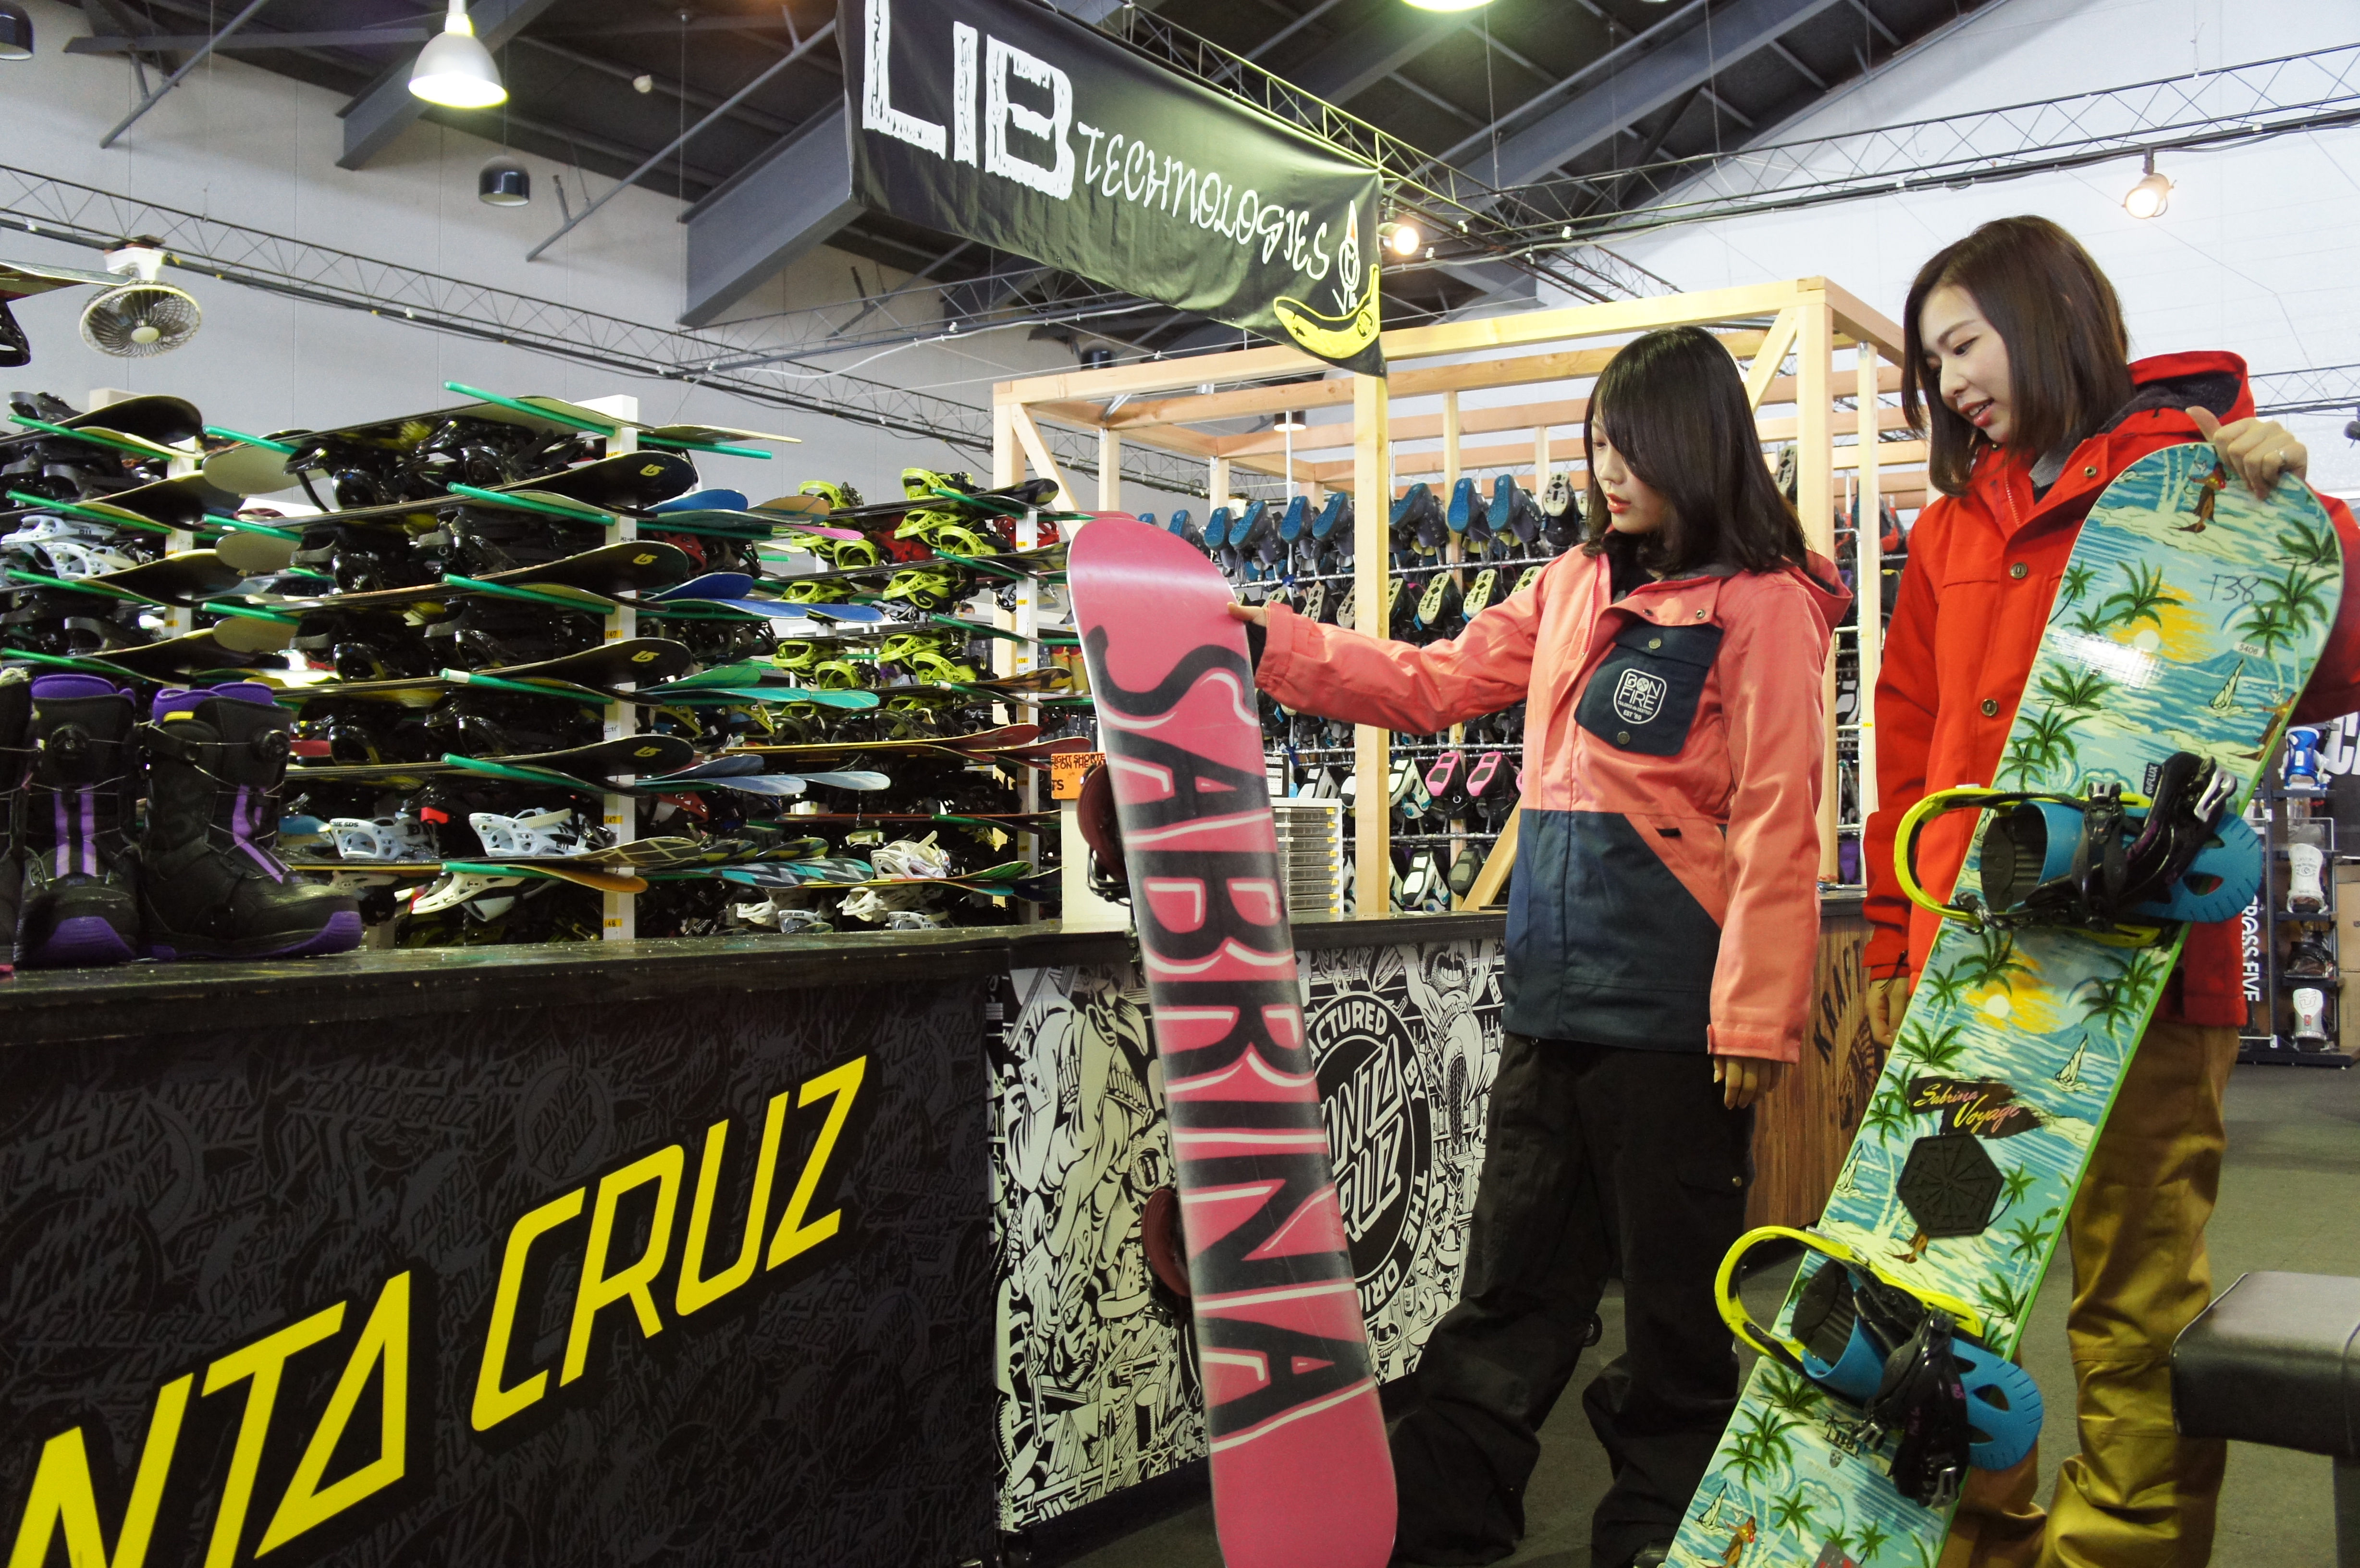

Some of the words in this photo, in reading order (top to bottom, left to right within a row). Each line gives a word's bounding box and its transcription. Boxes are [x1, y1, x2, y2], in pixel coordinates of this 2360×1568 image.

[862, 0, 1075, 200] LIB
[1077, 121, 1329, 280] TECHNOLOGIES
[2210, 574, 2261, 604] 138
[1619, 686, 1658, 711] FIRE
[1624, 673, 1662, 697] BON
[1623, 710, 1633, 718] EST
[2146, 764, 2158, 784] FLUX
[1086, 624, 1378, 1453] SABRINA
[1403, 1055, 1426, 1096] BY
[1913, 1083, 1978, 1107] Sabrina
[1953, 1094, 2020, 1134] Voyage
[1334, 1112, 1404, 1243] RUZ
[1402, 1170, 1428, 1251] THE
[471, 1055, 867, 1432] CRUZ
[1356, 1258, 1400, 1313] ORI
